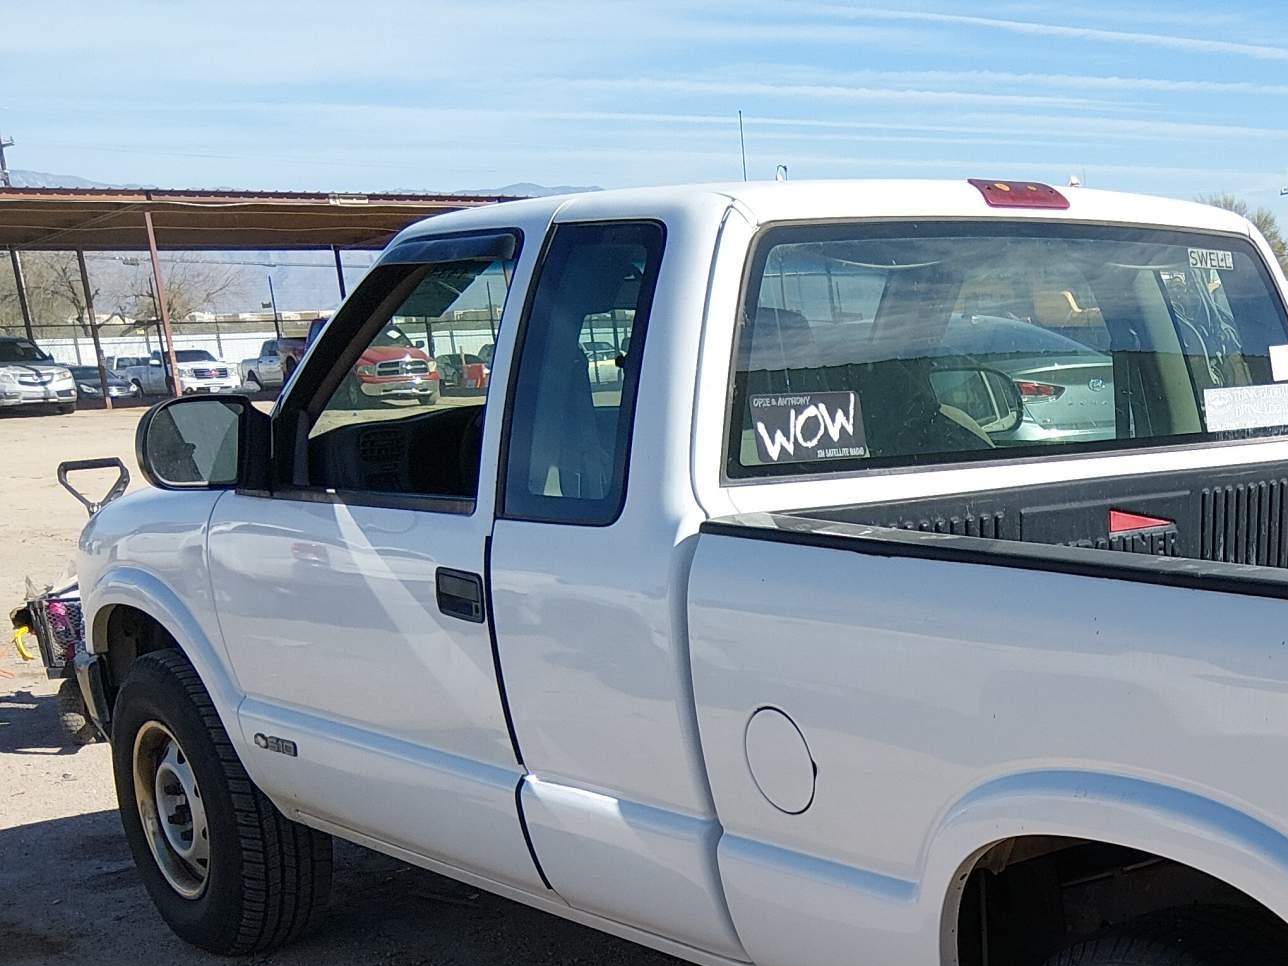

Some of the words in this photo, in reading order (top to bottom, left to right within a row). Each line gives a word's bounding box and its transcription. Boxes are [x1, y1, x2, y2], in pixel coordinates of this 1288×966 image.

[1189, 250, 1233, 269] SWELL
[753, 397, 771, 408] OPIE
[778, 395, 811, 407] ANTHONY
[757, 392, 855, 461] WOW
[826, 447, 850, 458] SATELLITE
[850, 446, 865, 457] RADIO
